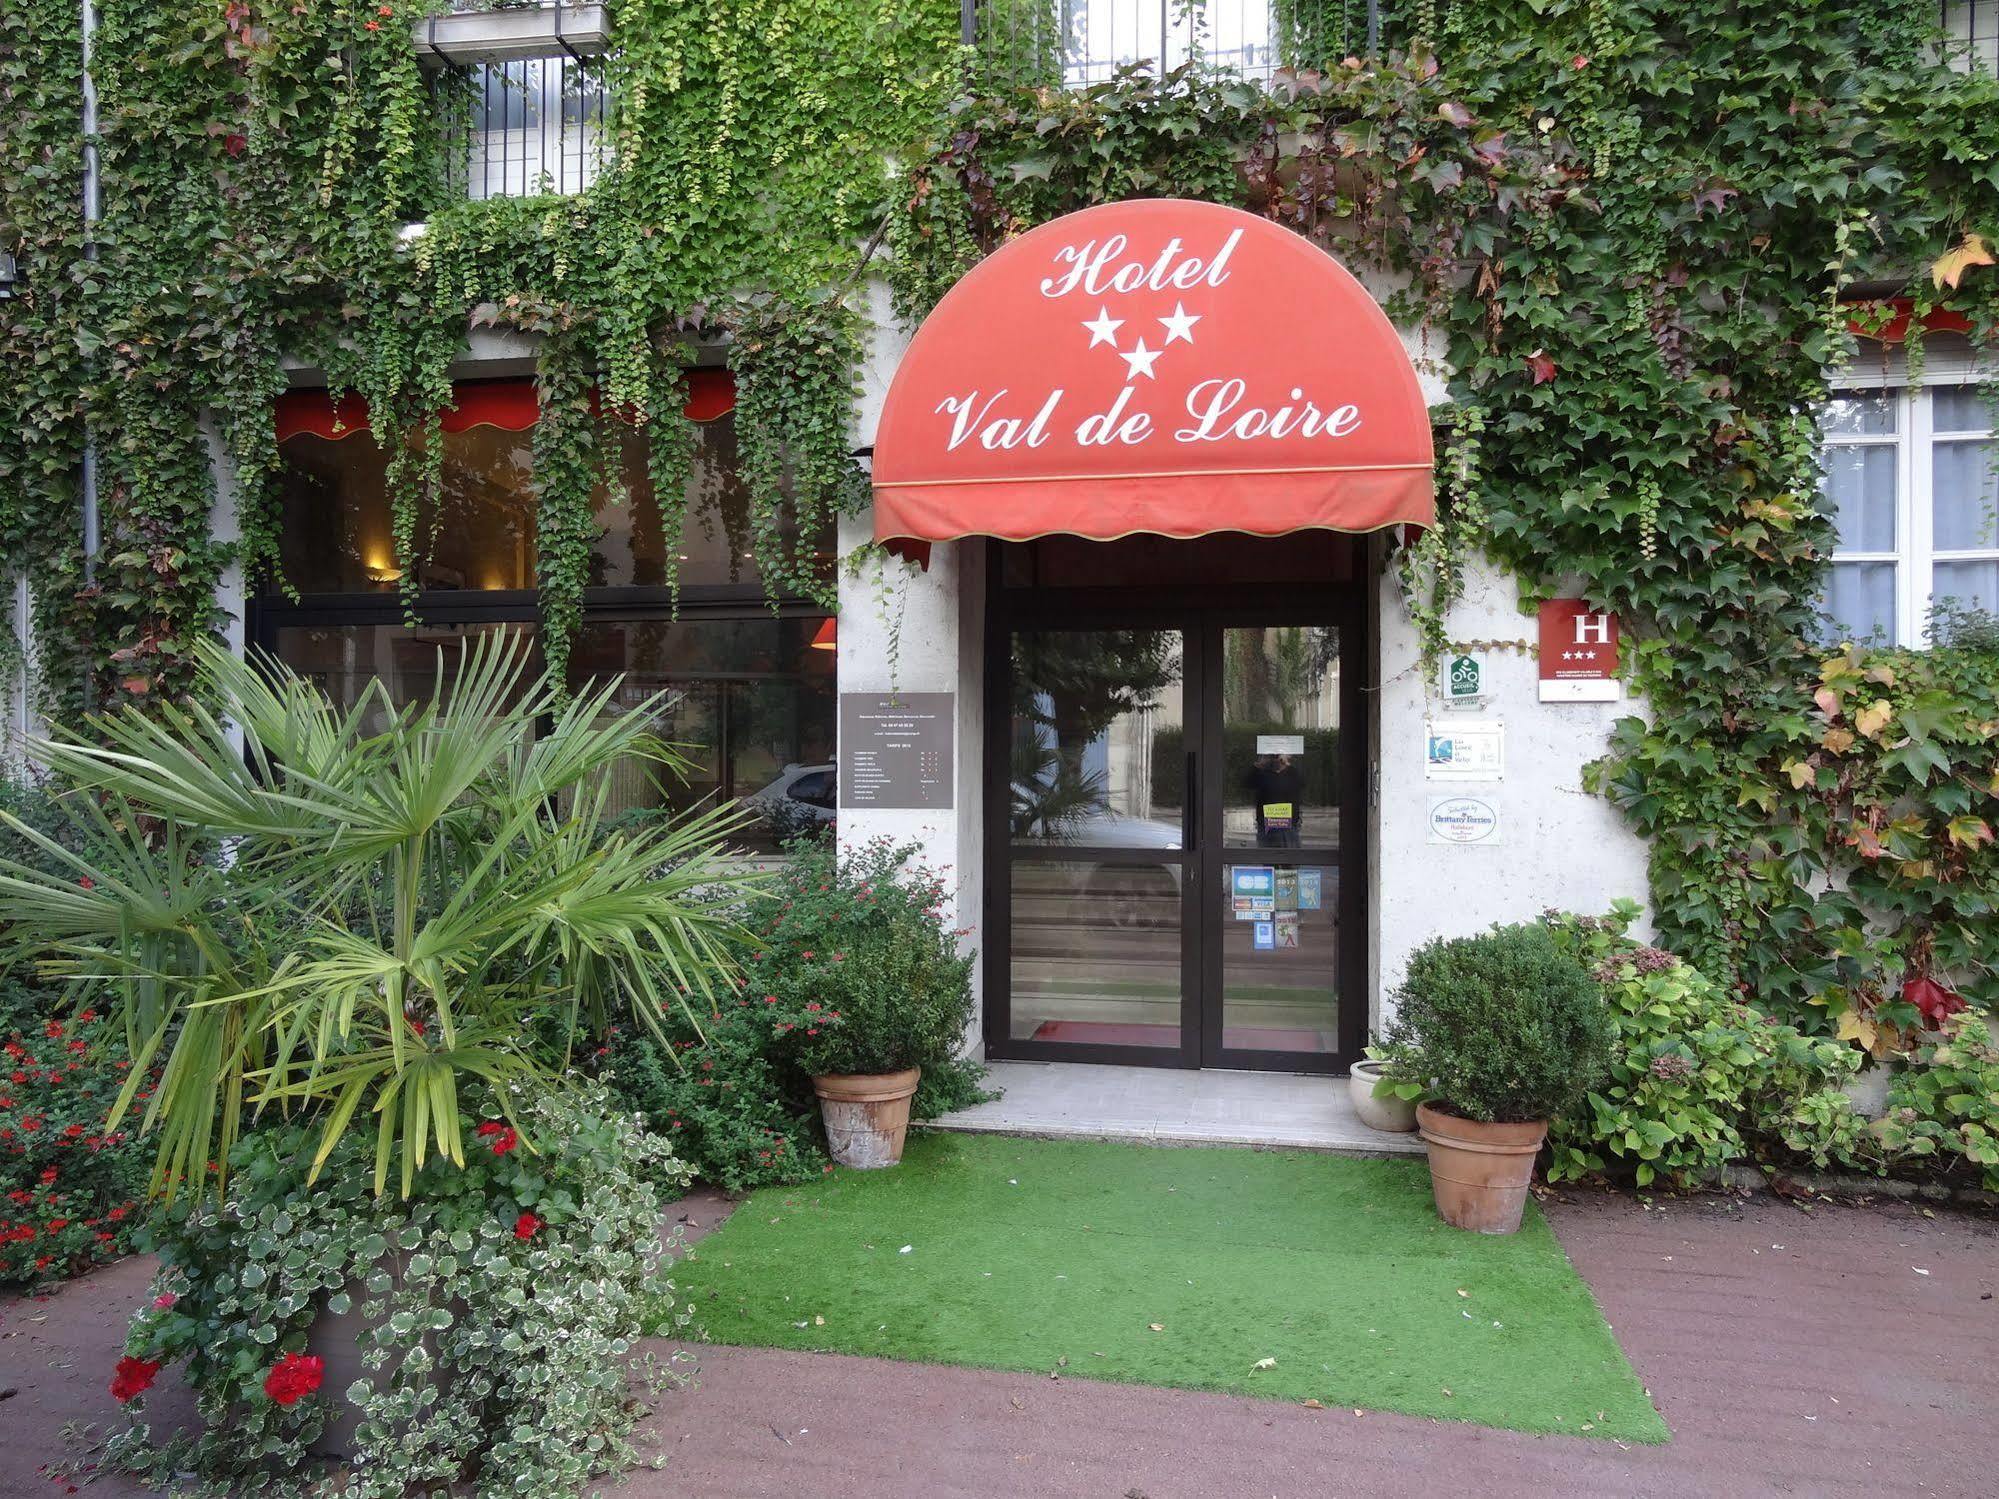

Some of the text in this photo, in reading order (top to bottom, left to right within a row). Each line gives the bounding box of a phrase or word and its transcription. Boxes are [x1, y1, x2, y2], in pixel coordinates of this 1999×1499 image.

[1040, 228, 1244, 298] Hotel
[935, 378, 1362, 452] Val de Loire
[1572, 614, 1612, 644] H
[1435, 814, 1492, 825] Brittany Ferries
